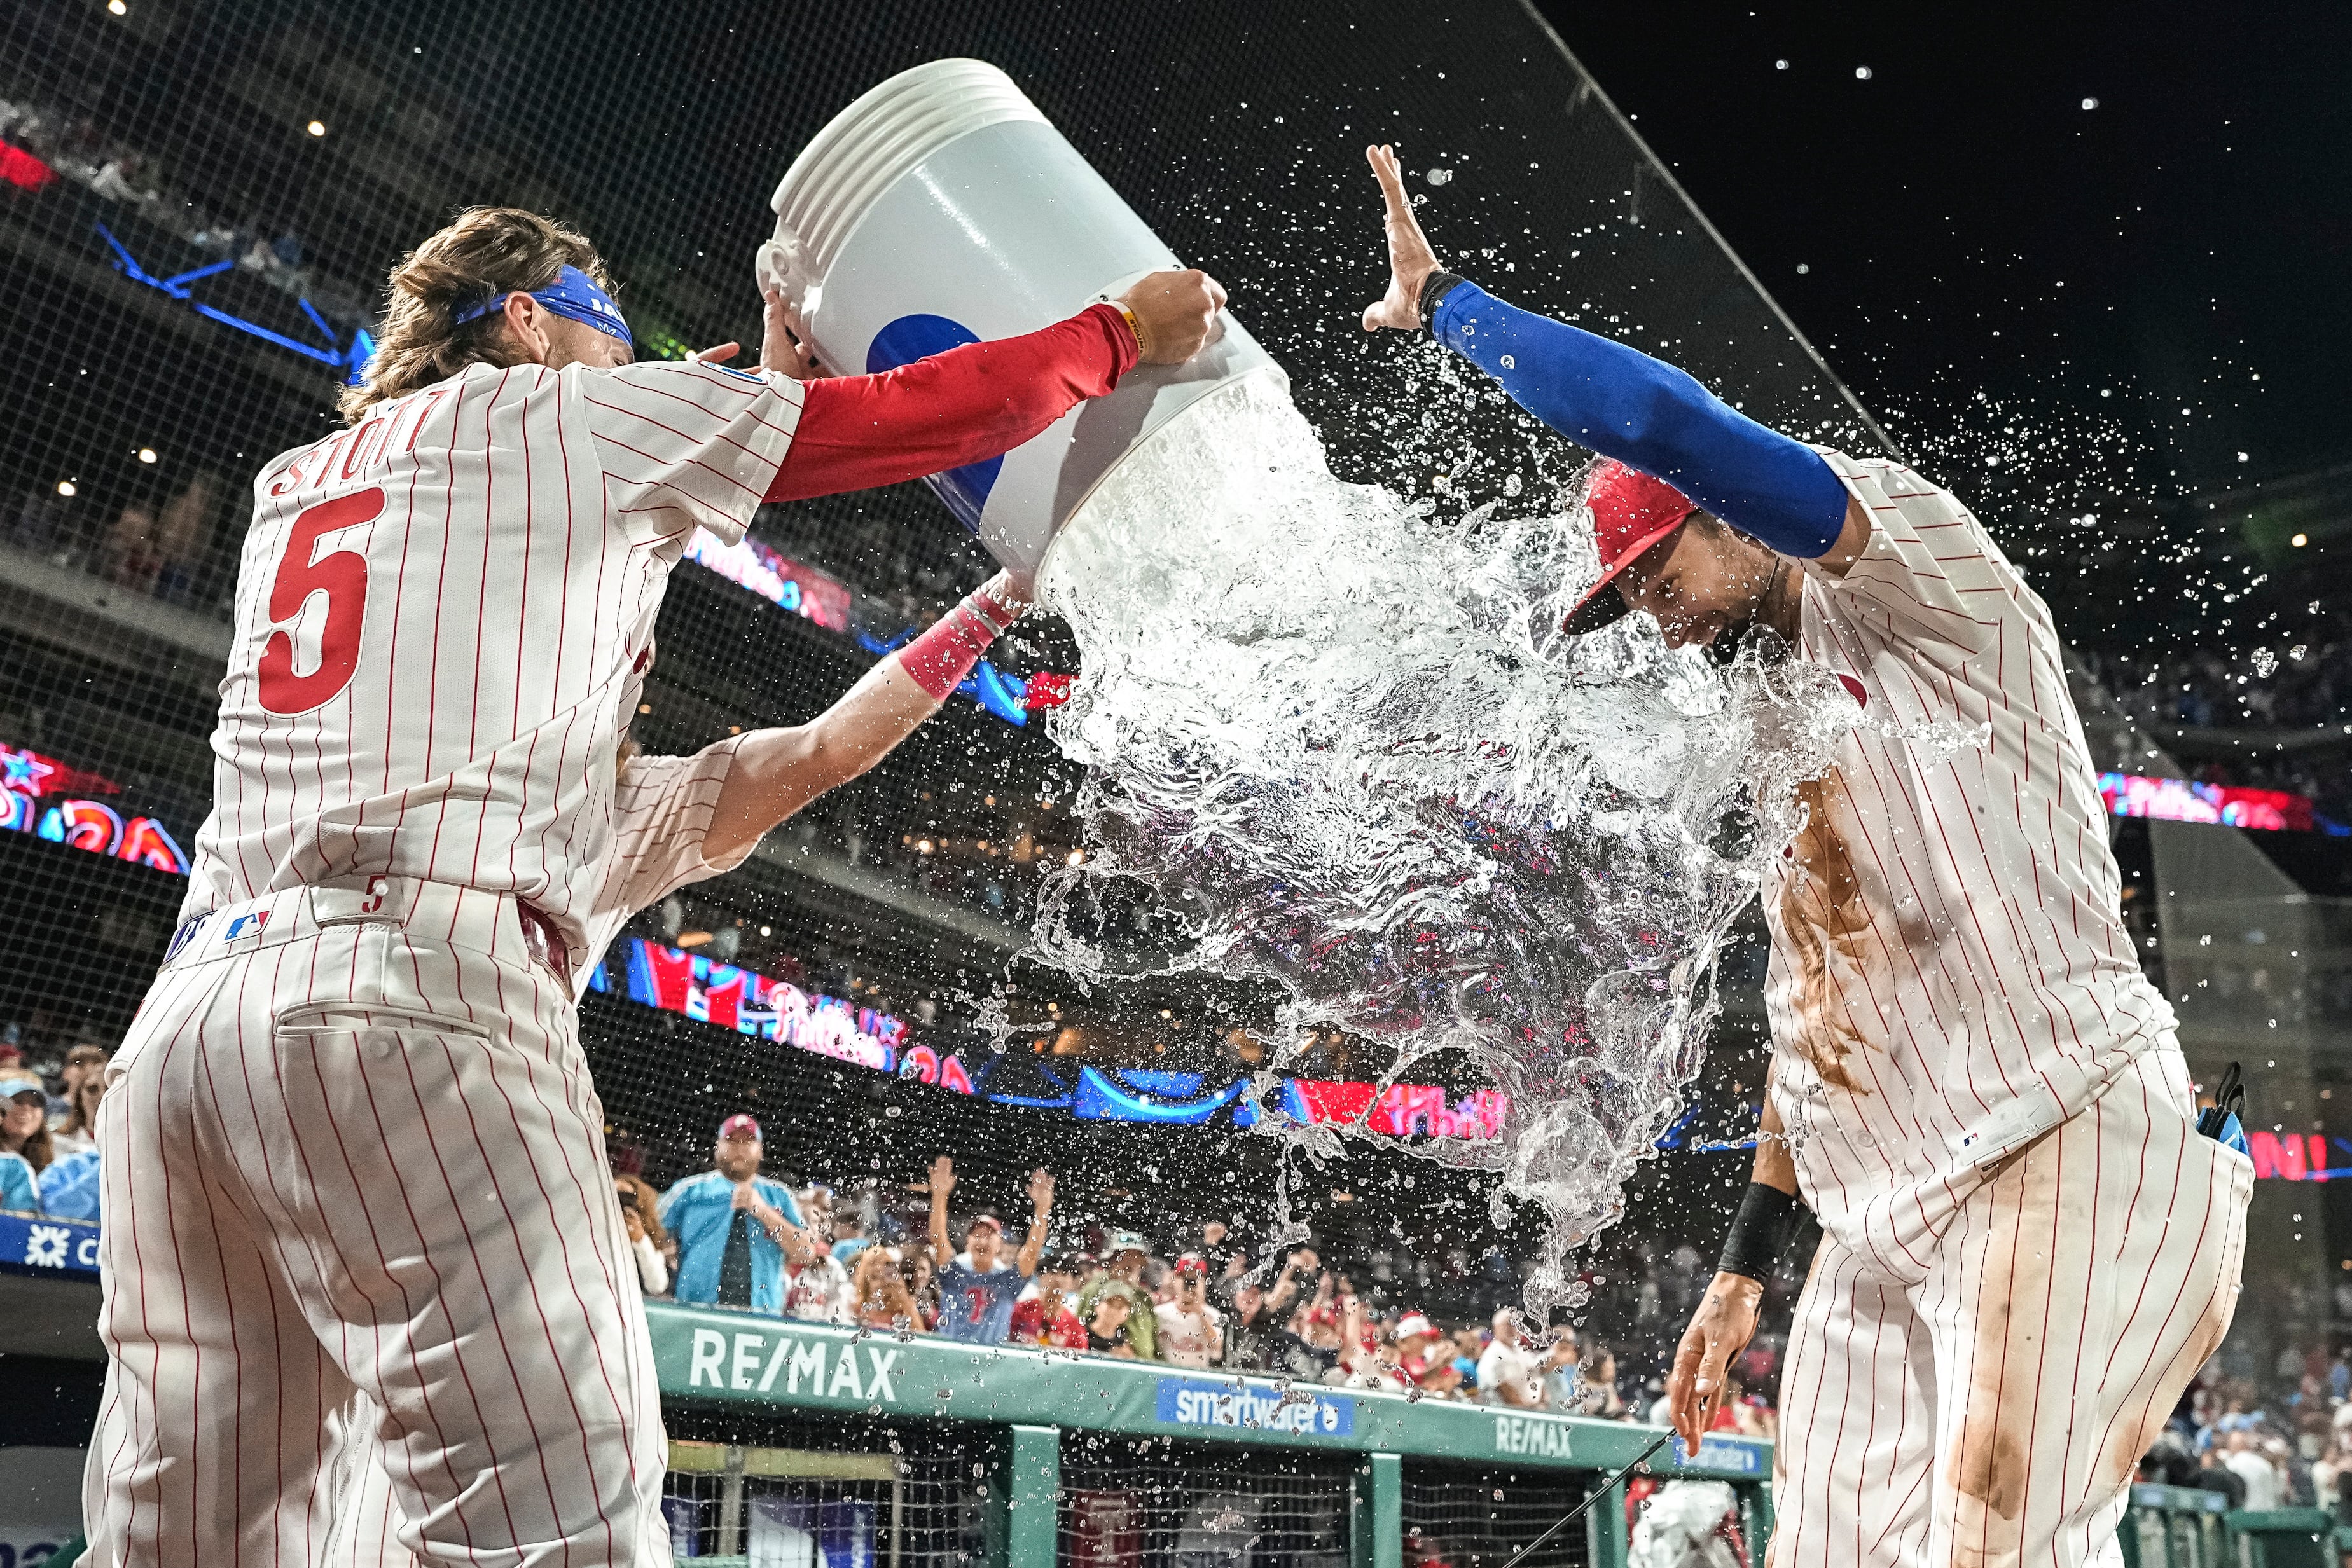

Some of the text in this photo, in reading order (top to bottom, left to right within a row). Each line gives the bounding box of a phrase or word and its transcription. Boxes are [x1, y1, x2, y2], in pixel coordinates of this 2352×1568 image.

[270, 389, 450, 497] STOTT
[258, 486, 387, 716] 5
[362, 875, 387, 913] 5
[689, 1328, 898, 1402] RE/MAX
[1495, 1415, 1572, 1459] RE/MAX
